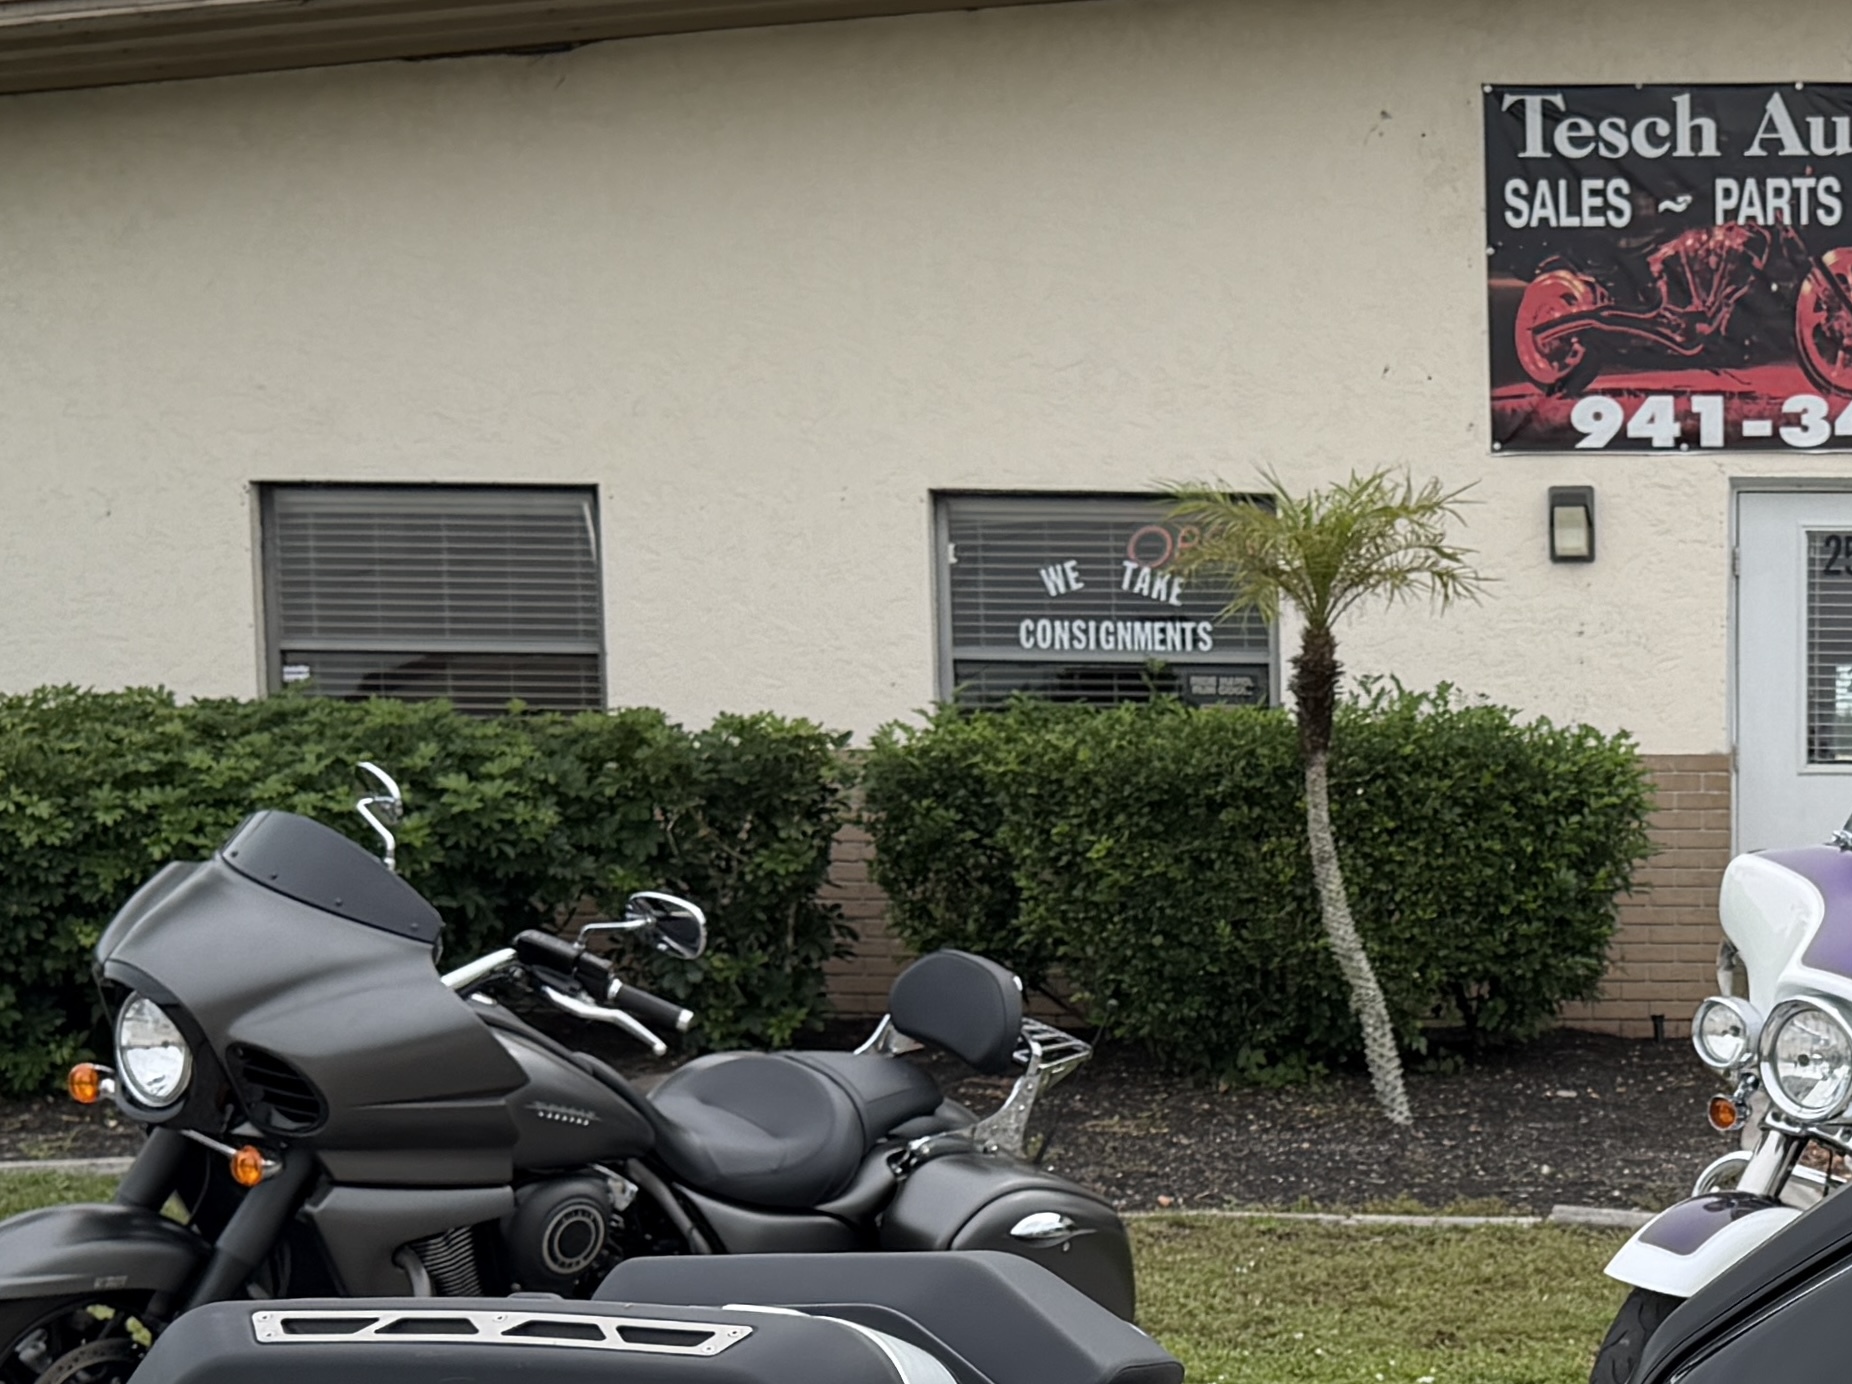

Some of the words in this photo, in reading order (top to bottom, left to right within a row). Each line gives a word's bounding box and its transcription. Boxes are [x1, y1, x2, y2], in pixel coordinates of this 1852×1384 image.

[1501, 92, 1722, 160] Tesch
[1503, 176, 1633, 230] SALES
[1714, 175, 1843, 227] PARTS
[1038, 559, 1085, 598] WE
[1120, 559, 1187, 607] TAKE
[1018, 619, 1214, 652] CONSIGNMENTS
